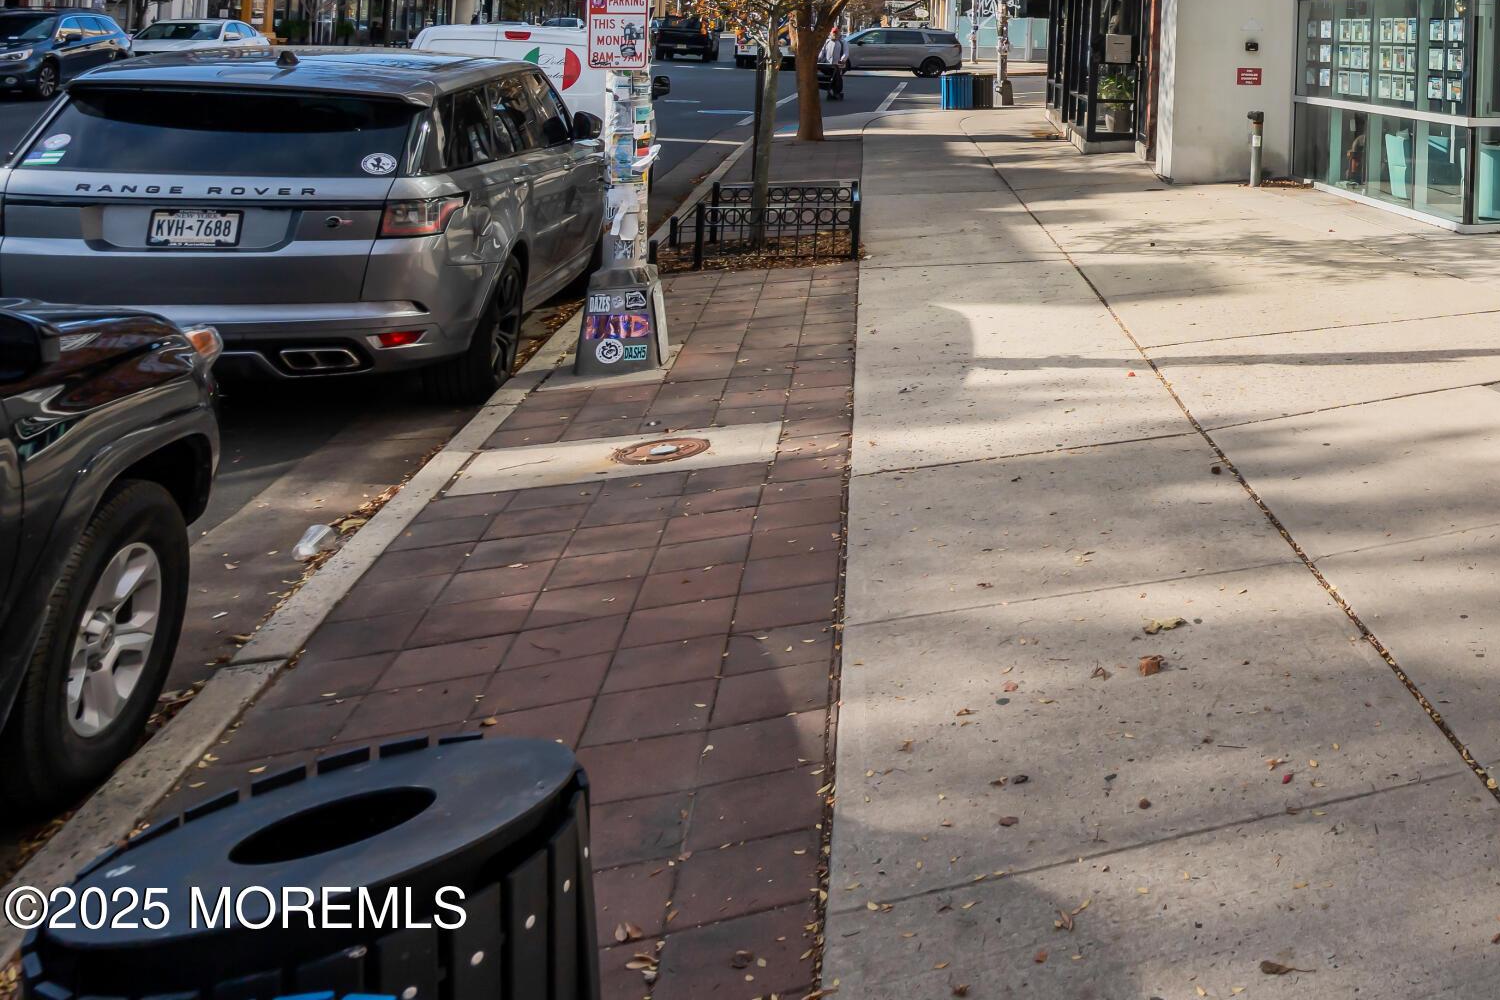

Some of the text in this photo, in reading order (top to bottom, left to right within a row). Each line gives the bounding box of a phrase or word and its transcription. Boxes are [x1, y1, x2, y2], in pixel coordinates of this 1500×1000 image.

[592, 18, 616, 30] THIS
[75, 183, 317, 196] RANGE ROVER
[155, 219, 232, 237] KVH 7688
[589, 296, 611, 313] DAZES
